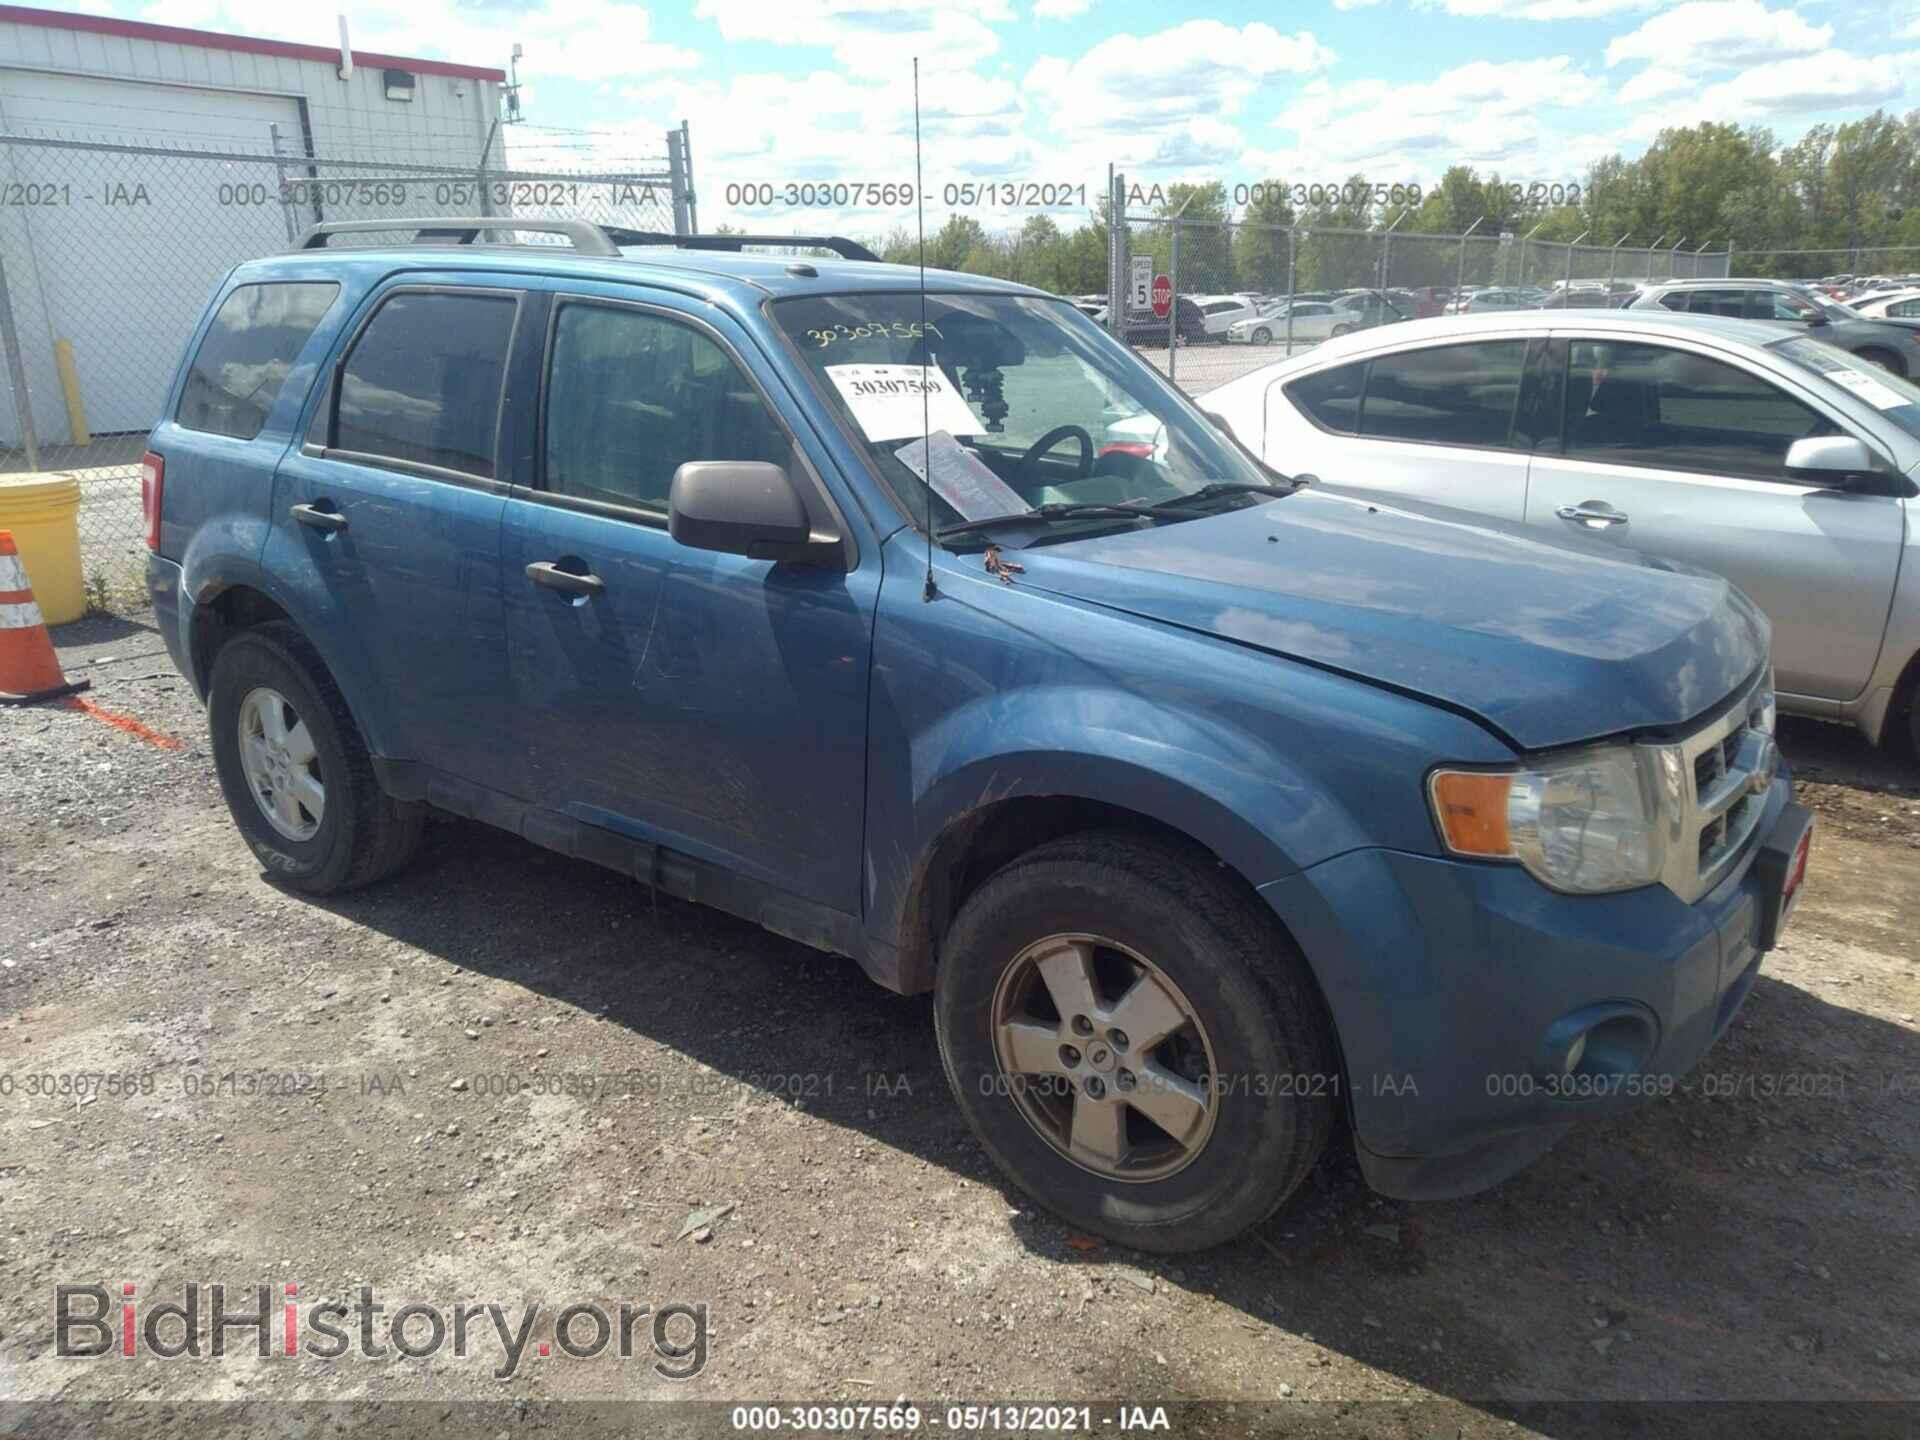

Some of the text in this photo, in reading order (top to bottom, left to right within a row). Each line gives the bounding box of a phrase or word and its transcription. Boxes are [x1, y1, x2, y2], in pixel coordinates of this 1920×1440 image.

[1137, 284, 1147, 305] 5
[1152, 288, 1171, 305] STOP
[807, 322, 944, 348] 30307569
[850, 380, 942, 396] 30307569
